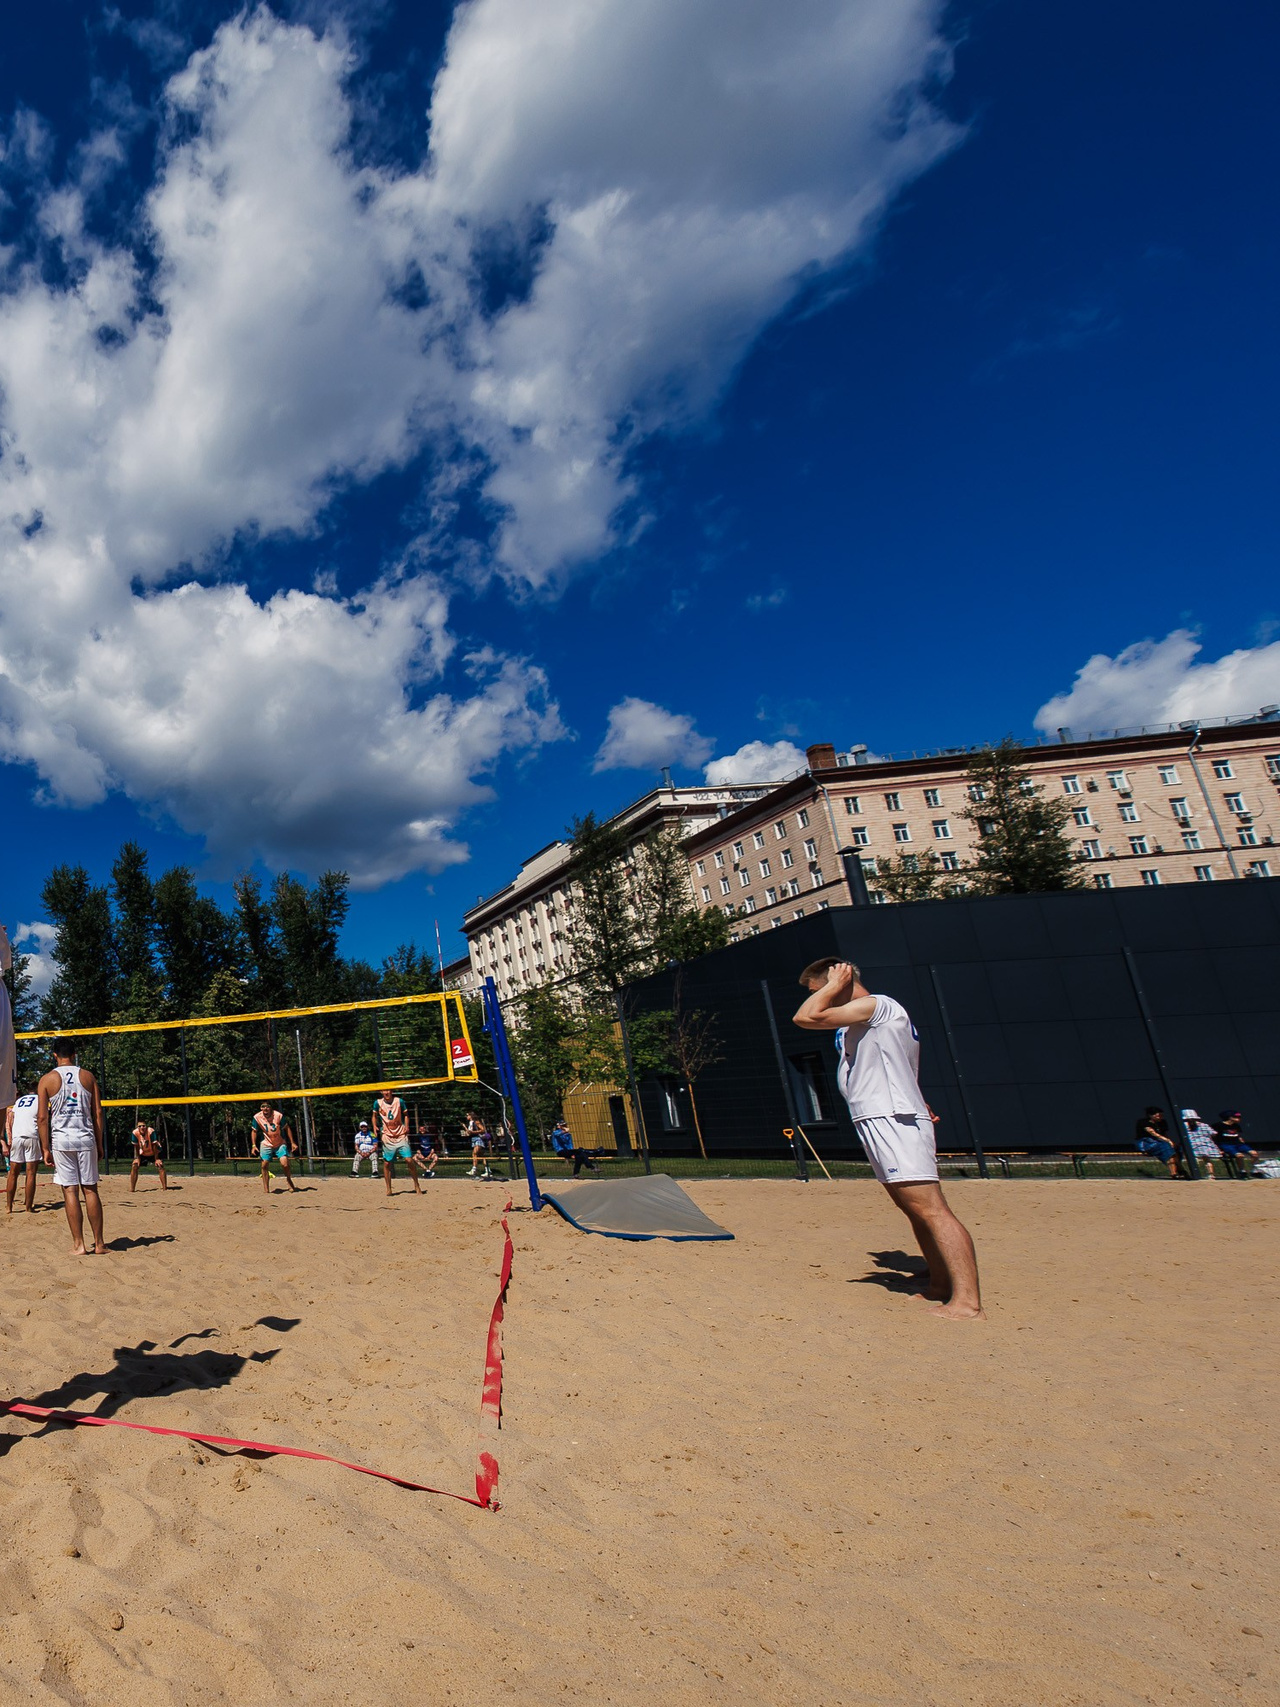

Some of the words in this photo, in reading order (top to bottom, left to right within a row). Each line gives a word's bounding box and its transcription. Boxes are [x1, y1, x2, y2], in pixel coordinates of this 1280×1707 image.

[453, 1045, 463, 1055] 2
[65, 1072, 74, 1085] 2
[17, 1096, 35, 1108] 63
[388, 1110, 394, 1120] 6
[263, 1123, 277, 1132] 13
